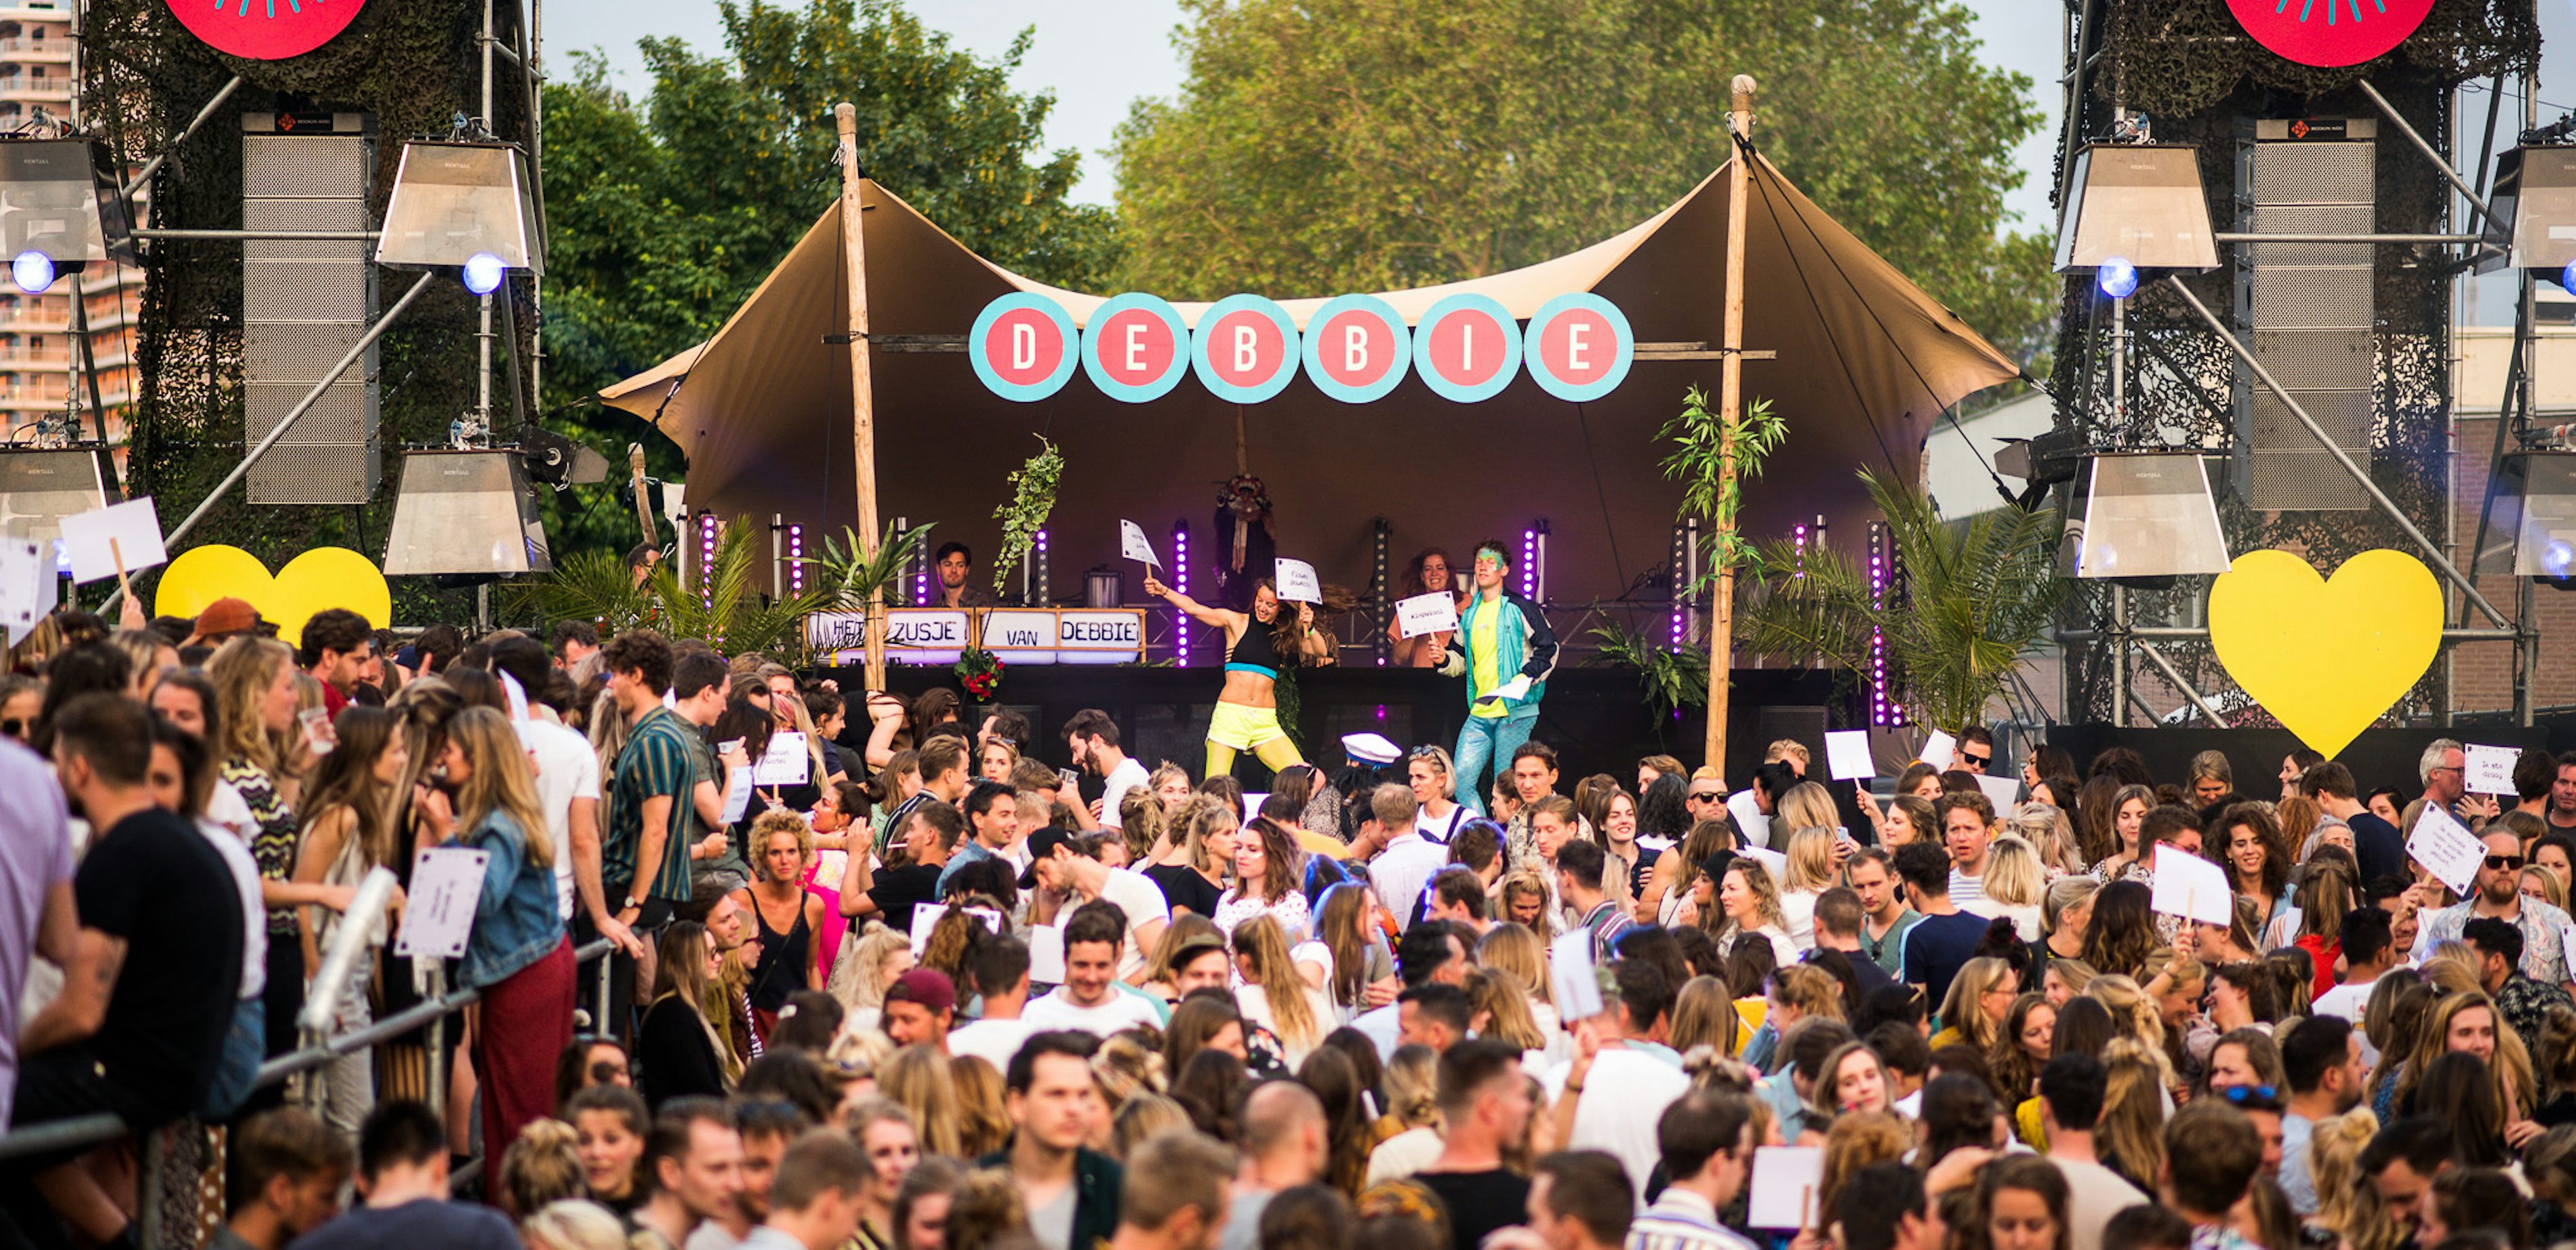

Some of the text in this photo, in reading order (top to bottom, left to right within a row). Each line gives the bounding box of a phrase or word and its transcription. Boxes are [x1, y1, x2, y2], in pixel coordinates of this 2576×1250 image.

[1013, 323, 1590, 372] DEBBIE
[833, 620, 1137, 647] HET ZUSJE VAN DEBBIE
